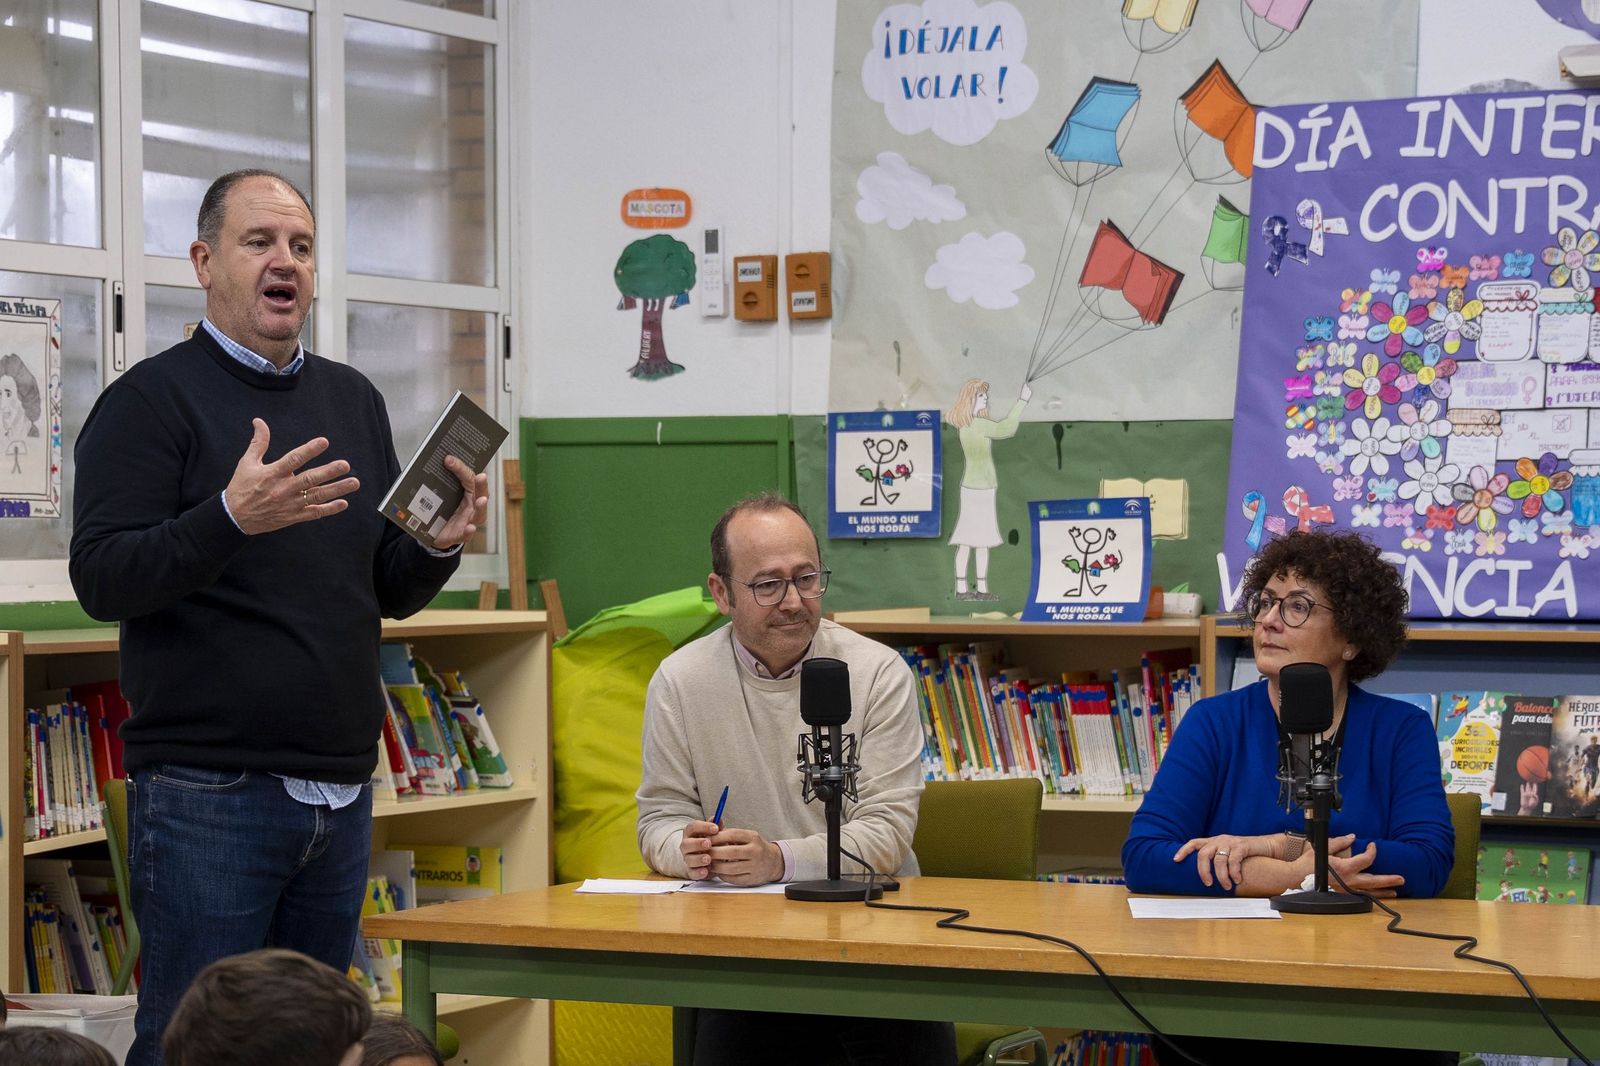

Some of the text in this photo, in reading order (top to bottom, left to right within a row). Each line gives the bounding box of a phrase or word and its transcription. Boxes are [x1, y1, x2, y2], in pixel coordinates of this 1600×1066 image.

[1252, 104, 1372, 173] DÍA
[630, 203, 683, 215] MASCOTA
[848, 515, 919, 525] EL MUNDO QUE
[856, 524, 911, 534] NOS RODEA
[1045, 606, 1124, 614] EL MUNDO QUE
[1052, 613, 1112, 621] NOS RODEA
[1512, 715, 1535, 724] para
[1450, 760, 1494, 770] DEPORTE
